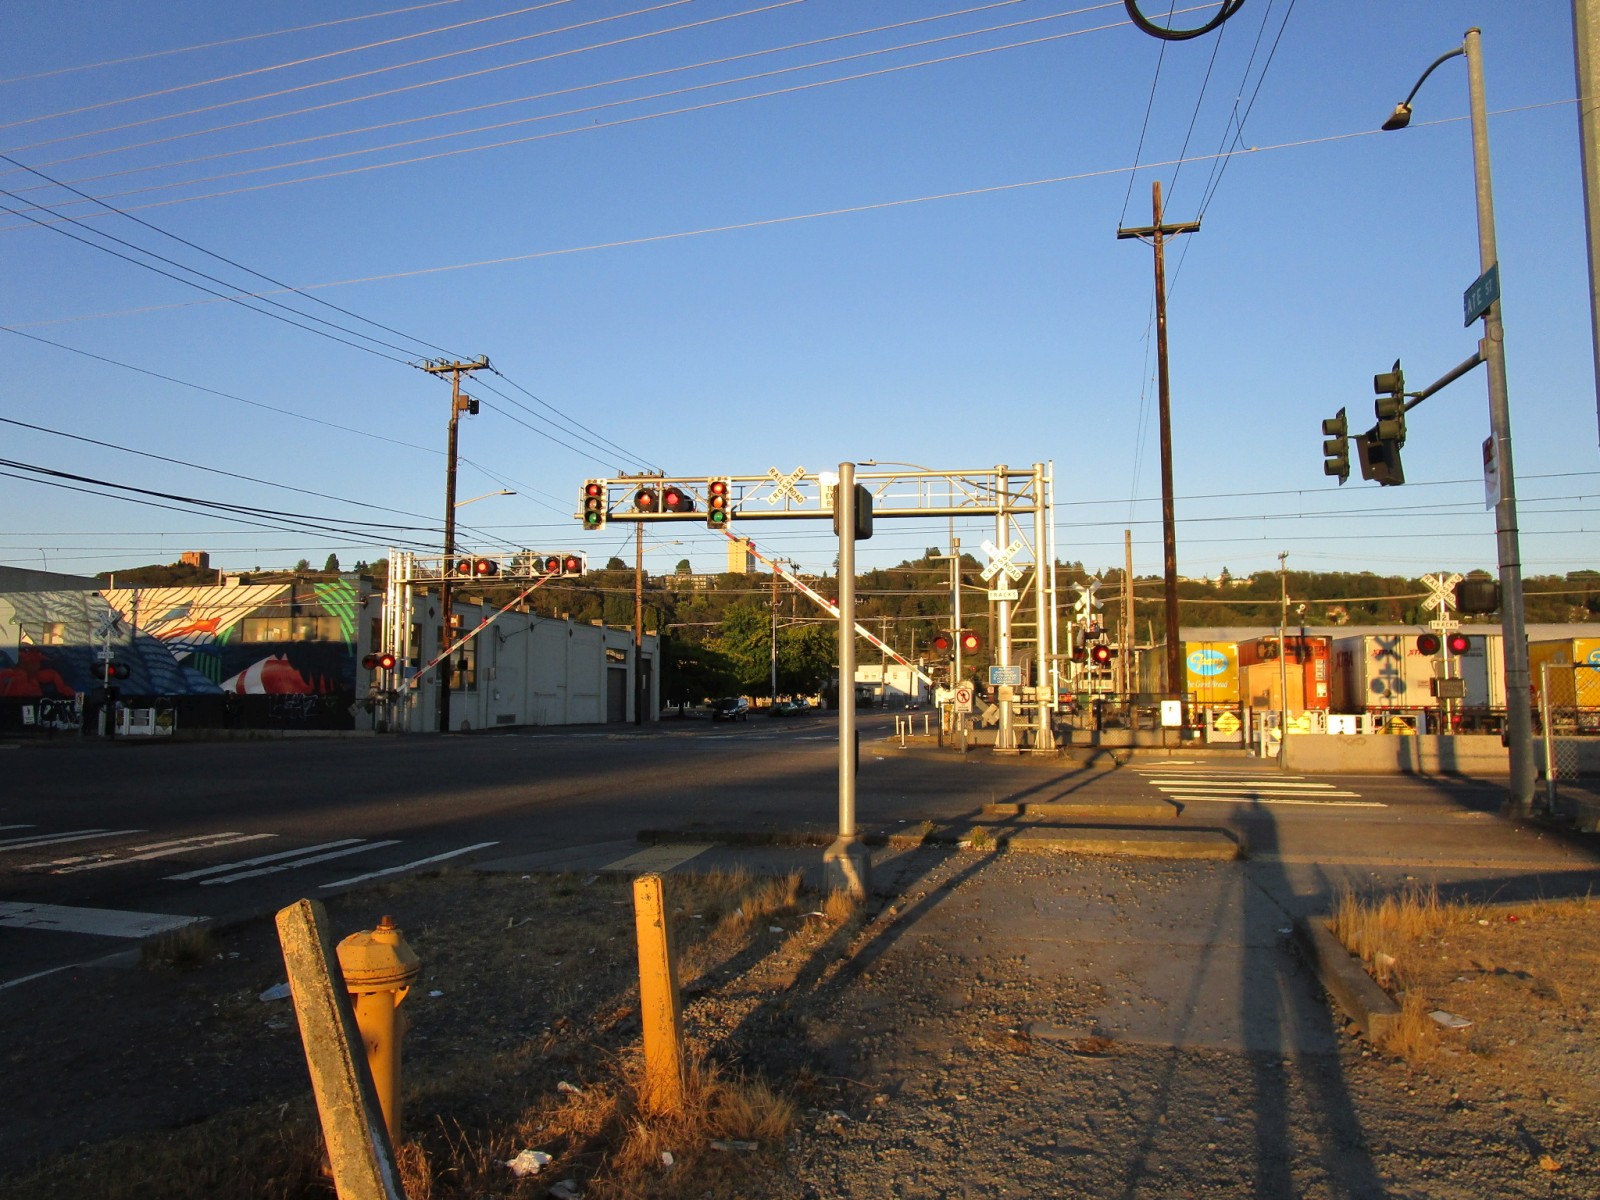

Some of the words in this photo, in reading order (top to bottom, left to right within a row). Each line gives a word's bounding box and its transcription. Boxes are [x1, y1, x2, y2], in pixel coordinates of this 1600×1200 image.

[1485, 278, 1493, 296] ST
[767, 466, 805, 504] CROSSING
[981, 540, 1021, 579] CROSSING
[1426, 575, 1461, 609] CROSSING
